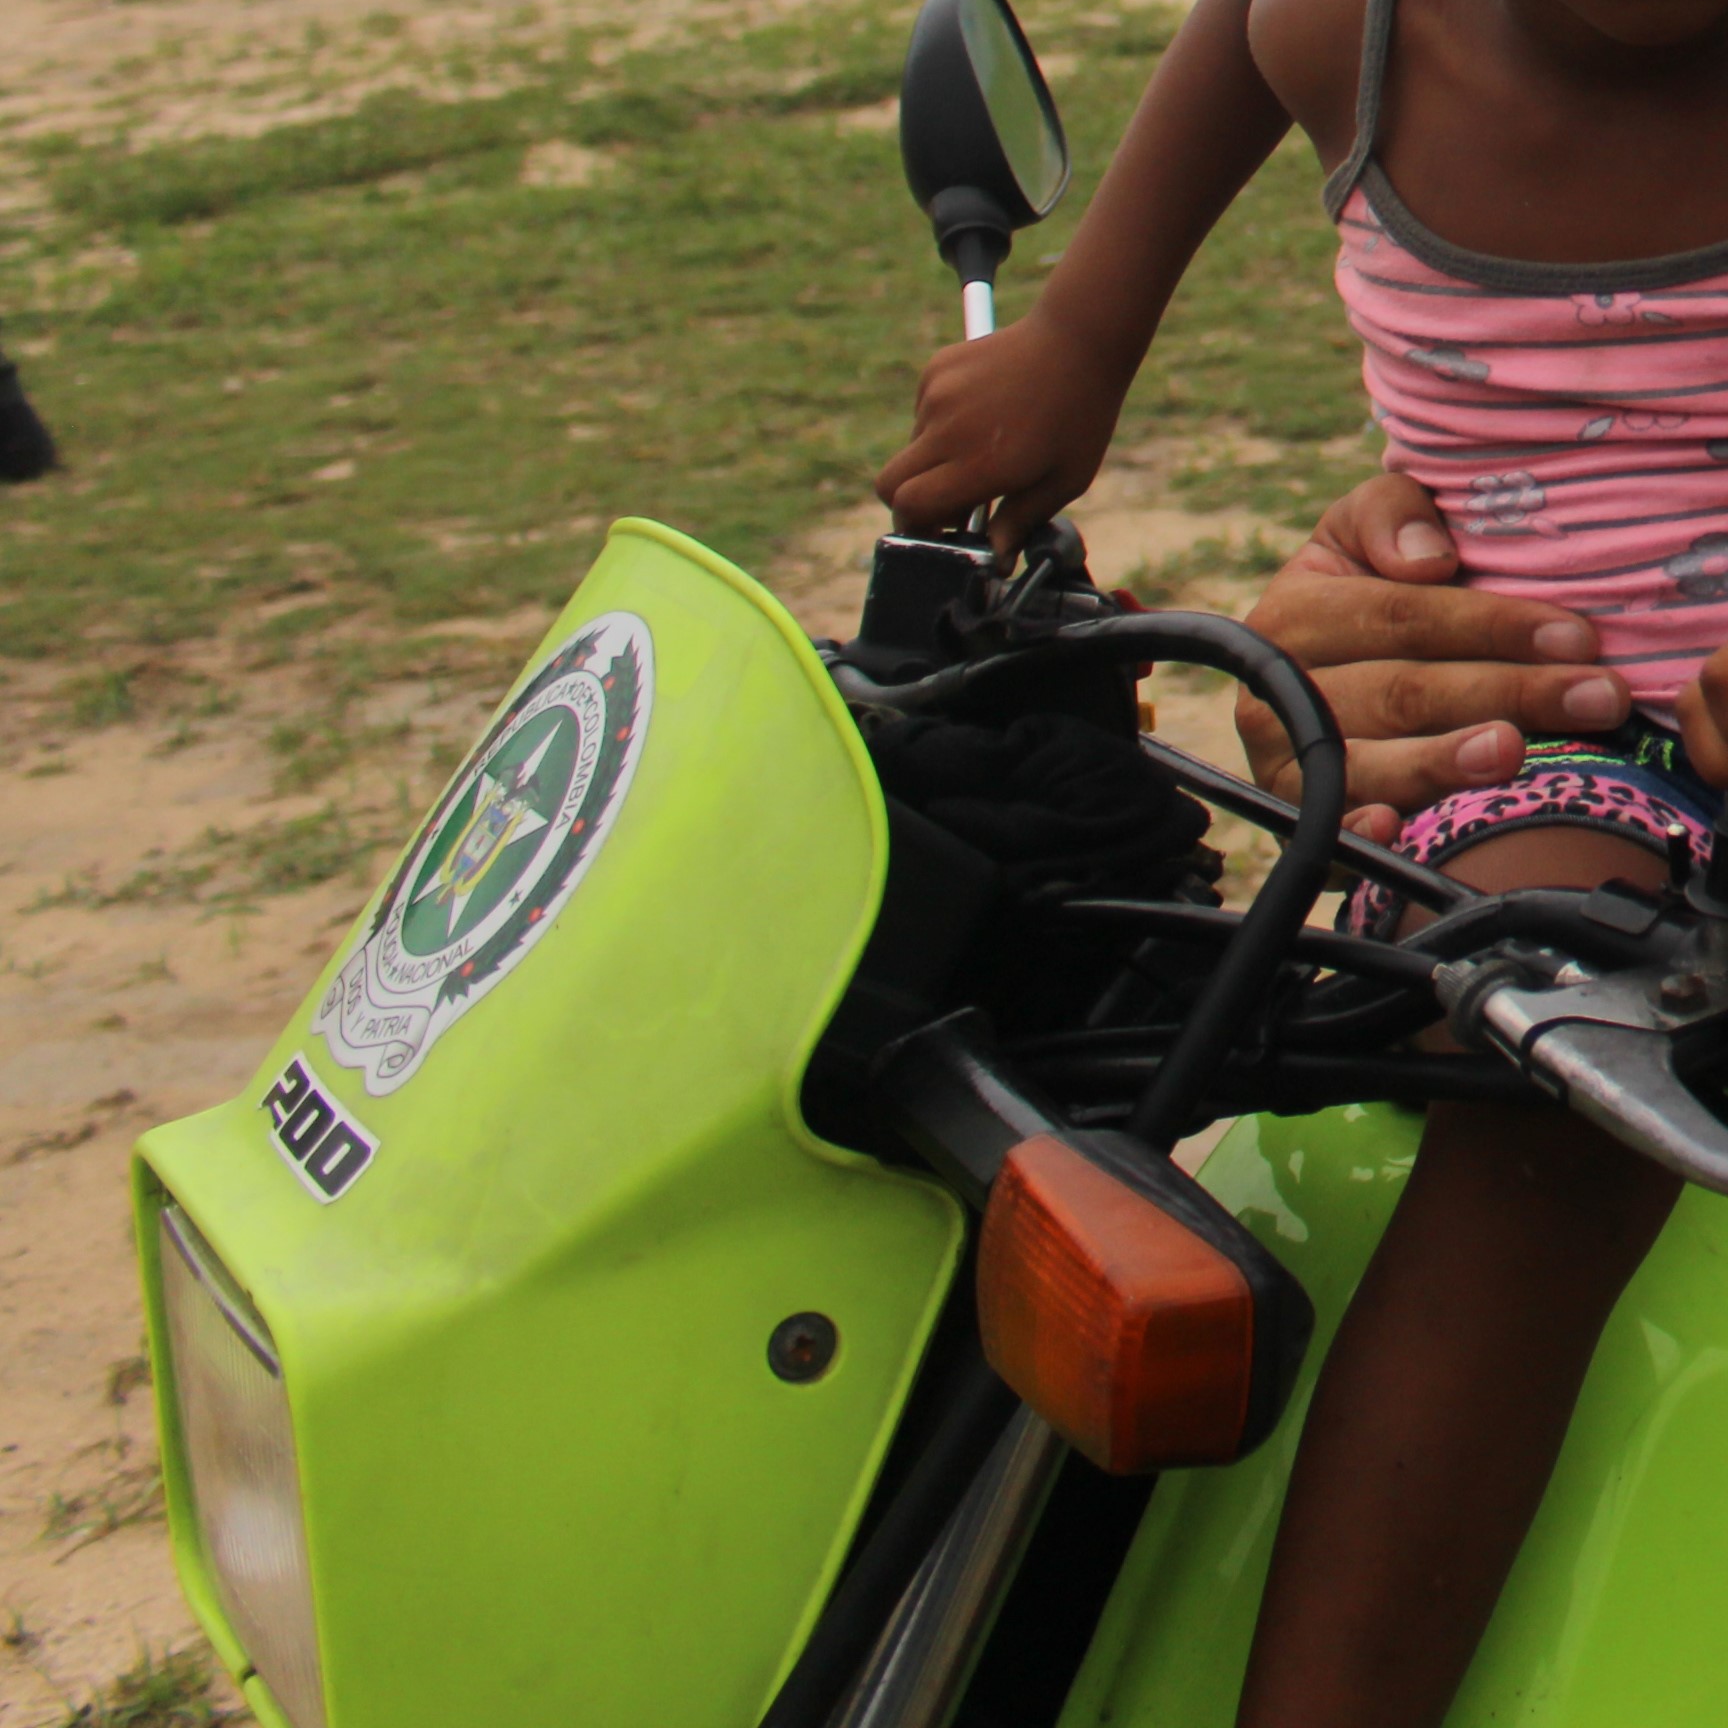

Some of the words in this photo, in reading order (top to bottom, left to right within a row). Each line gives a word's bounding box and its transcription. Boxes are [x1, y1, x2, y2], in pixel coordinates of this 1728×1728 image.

[555, 700, 601, 830] COLOMBIA
[394, 938, 474, 985] NACIONAL
[350, 1011, 365, 1032] Y
[360, 1015, 413, 1040] PATRIA
[261, 1059, 372, 1198] 200
